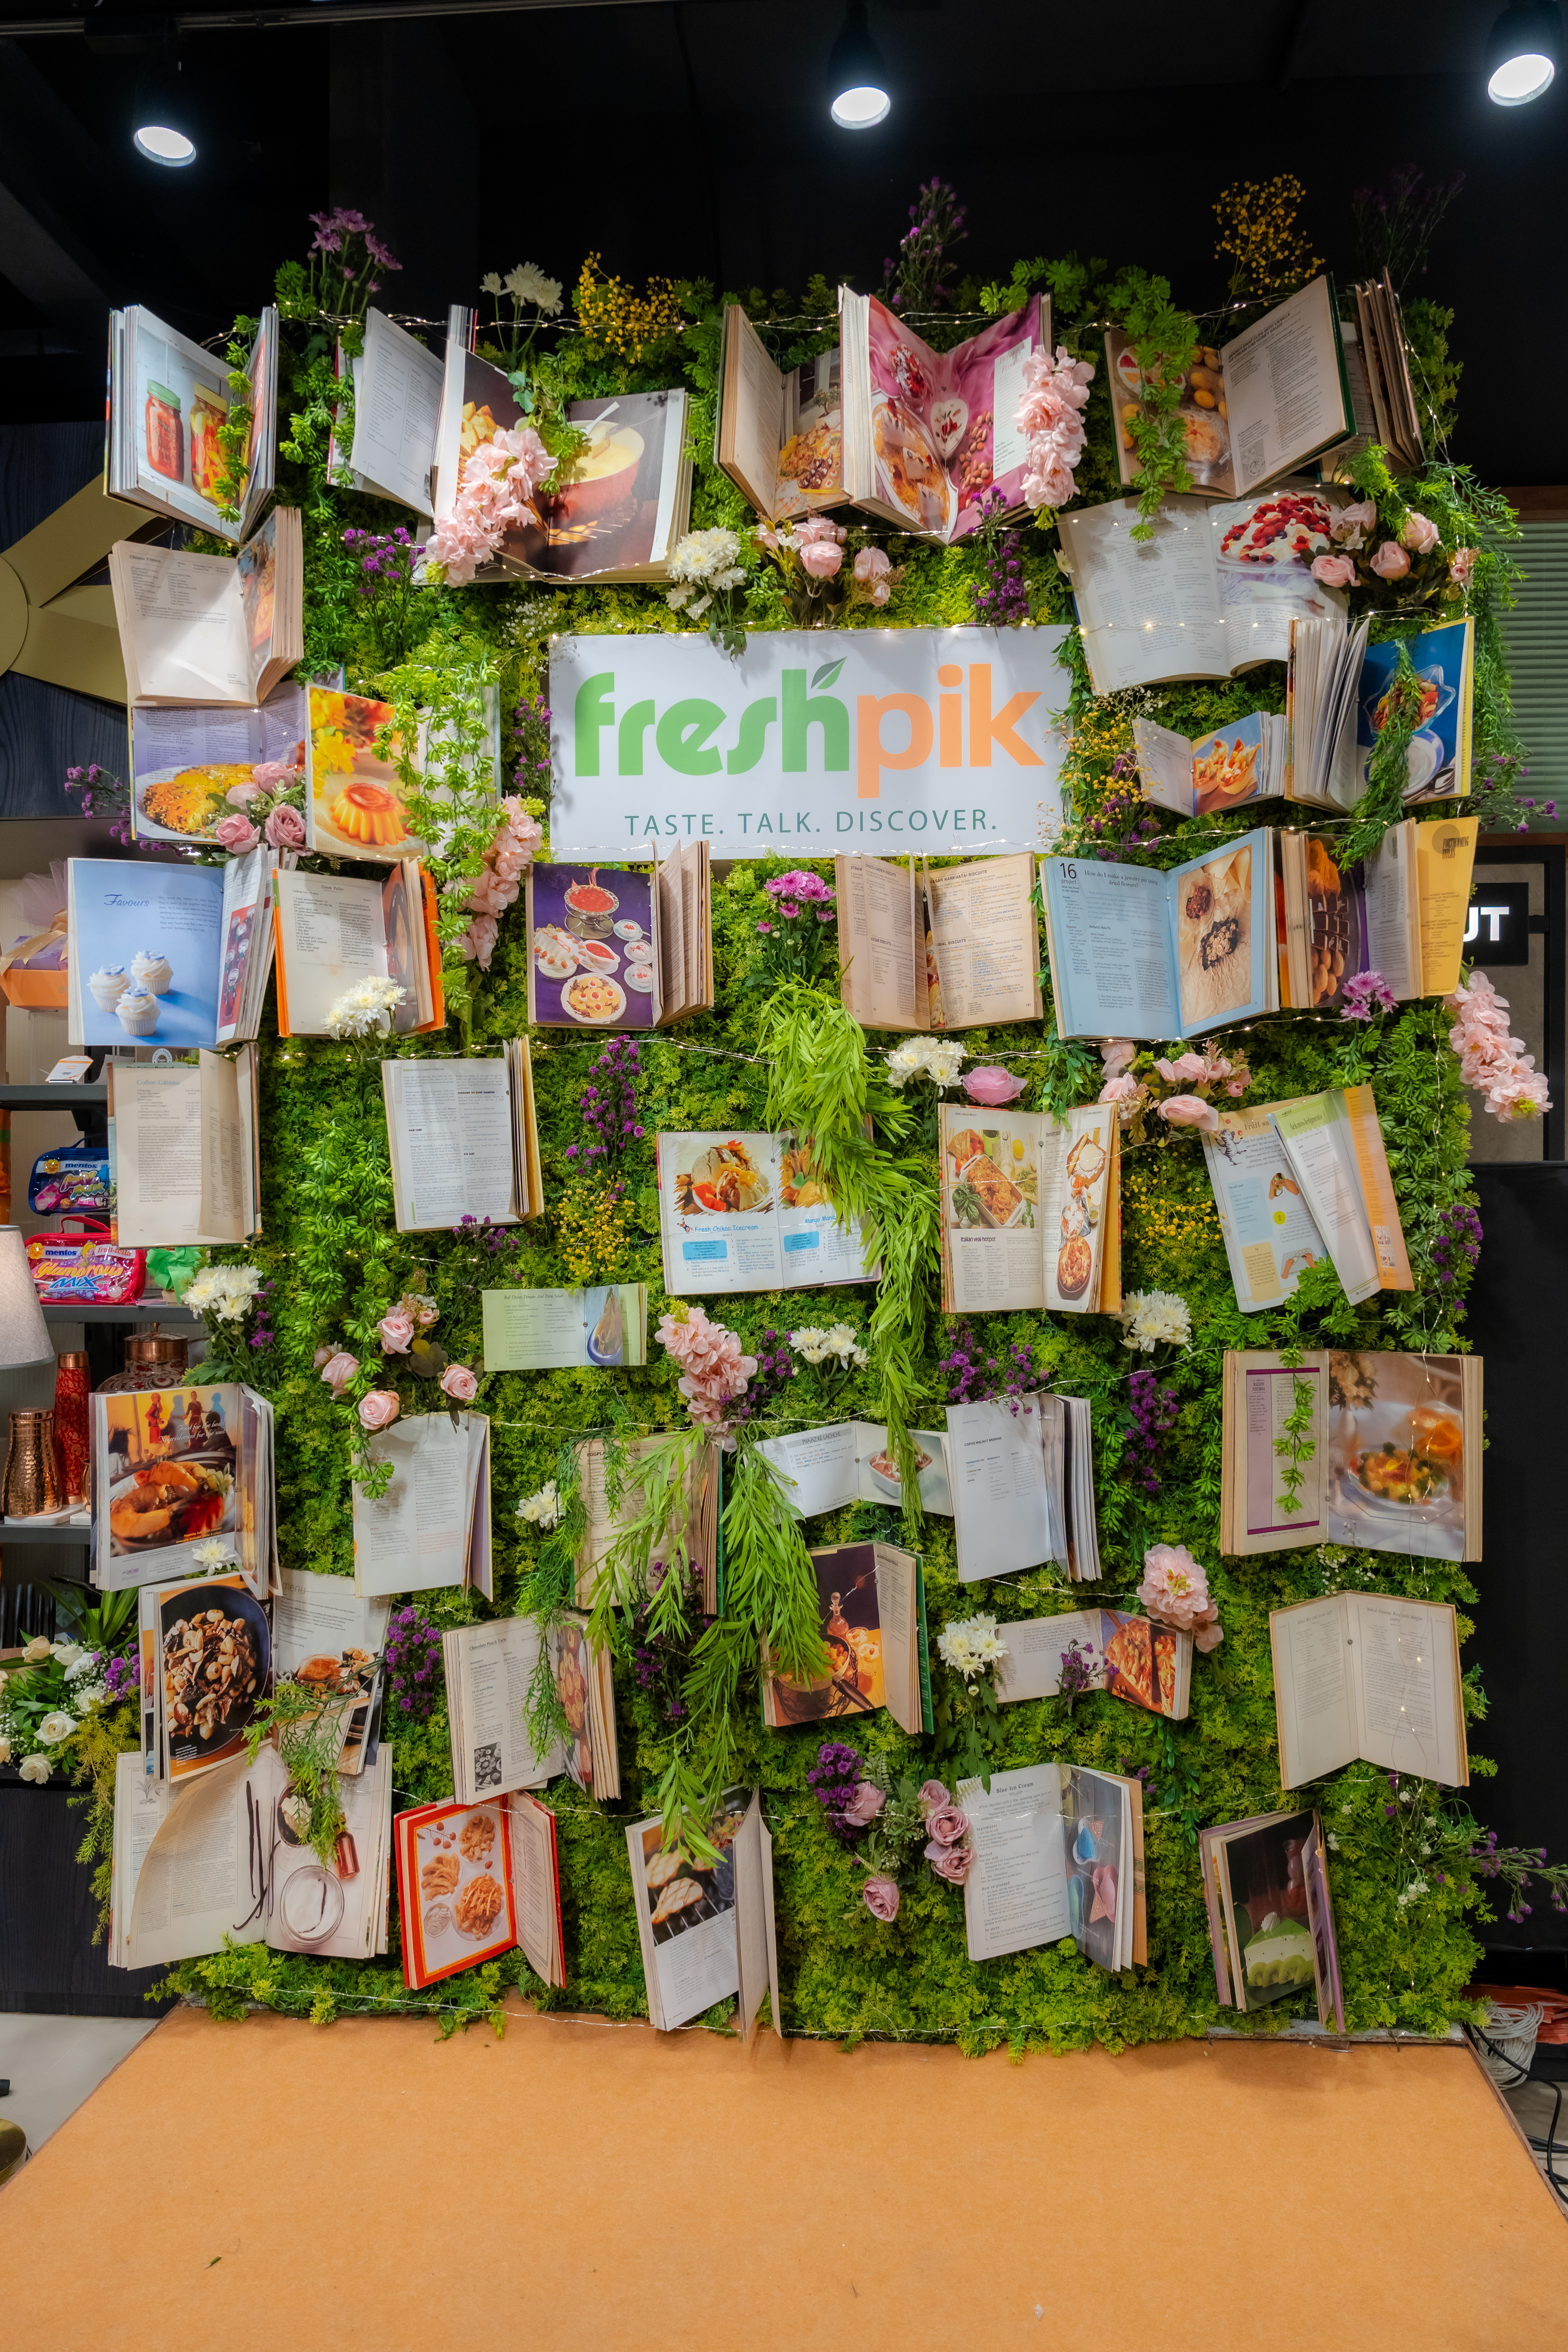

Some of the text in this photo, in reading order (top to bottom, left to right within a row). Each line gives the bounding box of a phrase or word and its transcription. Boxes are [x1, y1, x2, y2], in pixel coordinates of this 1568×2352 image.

[1111, 516, 1128, 525] Cool
[574, 663, 1047, 799] freshpik
[624, 809, 997, 836] TASTE. TALK. DISCOVER.
[1443, 836, 1469, 849] FORTHCOMING
[1442, 847, 1455, 859] TITLES
[1060, 863, 1077, 879] 16
[104, 894, 149, 907] Favours
[153, 1049, 171, 1060] VANITY FEMME
[1244, 1121, 1260, 1130] Fruit
[1289, 1114, 1322, 1131] Acknowledgments
[34, 1262, 124, 1279] Glamorous
[178, 1424, 192, 1432] Food
[192, 1423, 201, 1432] for
[159, 1433, 196, 1442] Nourishment
[196, 1431, 205, 1440] for
[283, 1582, 306, 1594] menu
[469, 1642, 486, 1650] Chocolate
